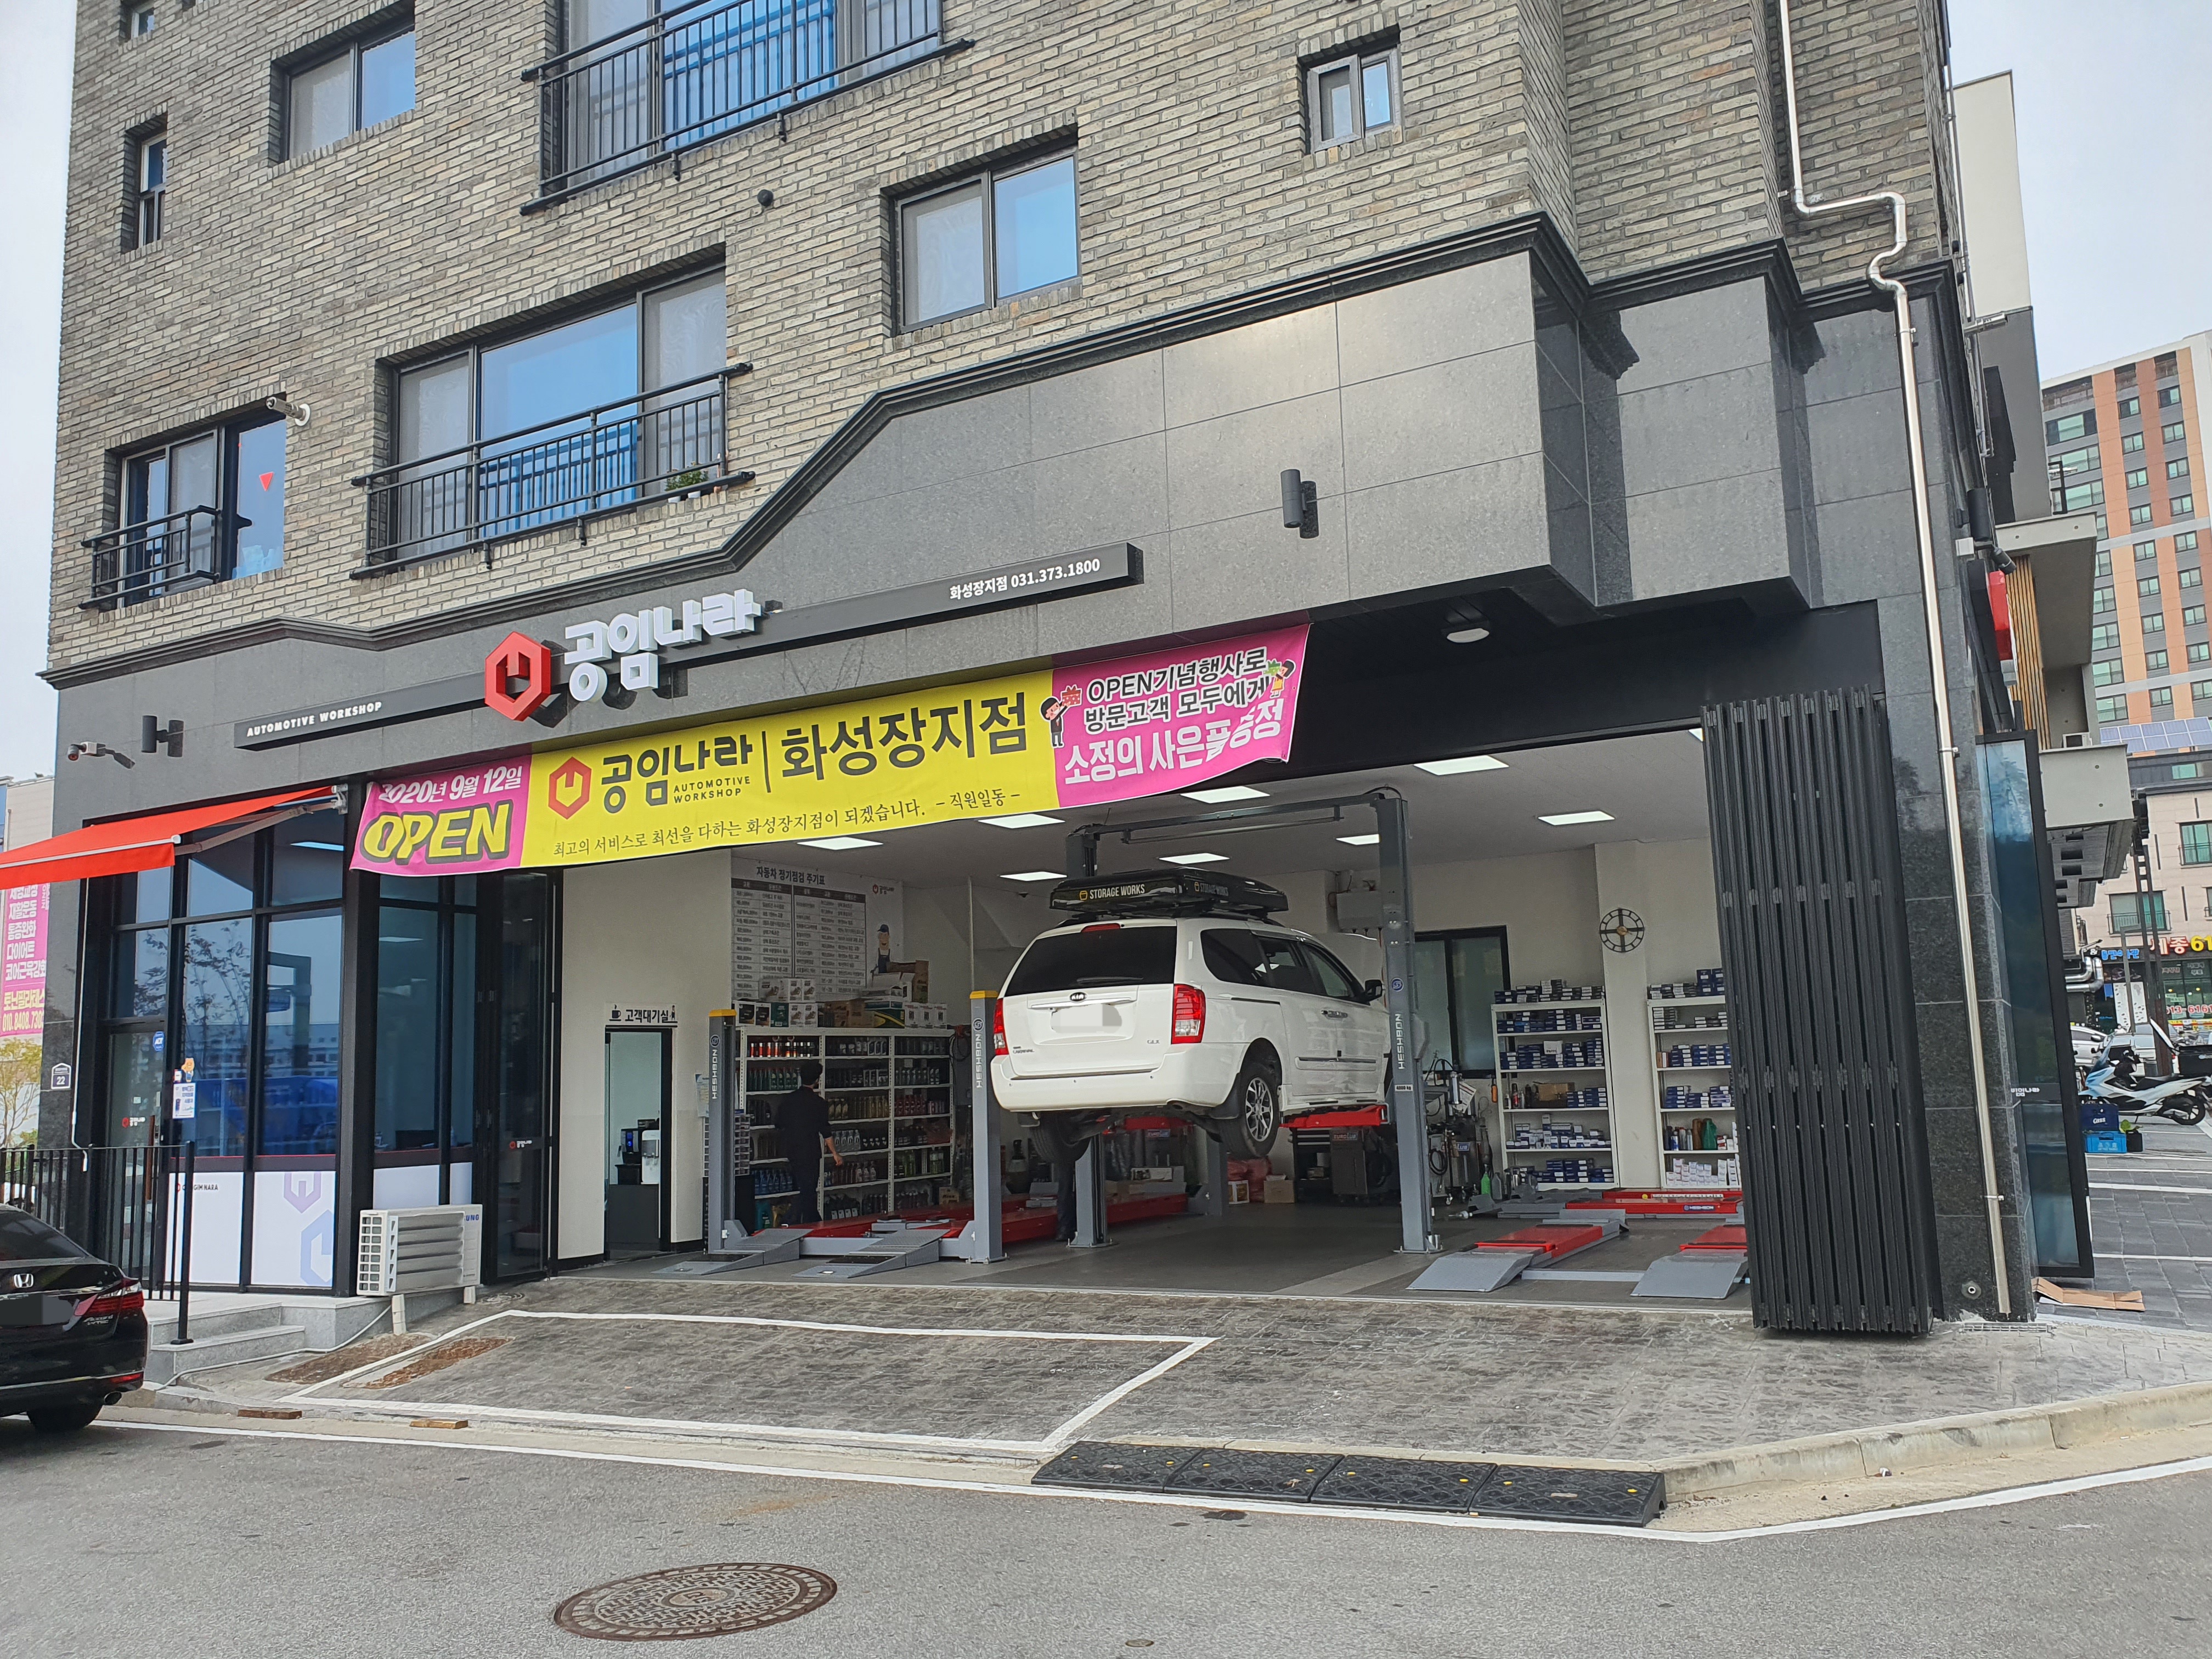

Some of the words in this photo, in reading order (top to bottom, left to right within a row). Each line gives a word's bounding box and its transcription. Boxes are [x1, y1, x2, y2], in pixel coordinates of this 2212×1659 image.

[950, 575, 1007, 600] 화성장지점
[1011, 558, 1101, 588] 031.373.1800
[564, 588, 761, 702] 공임나라
[1087, 646, 1267, 704] OPEN기념행사로
[247, 715, 315, 737] AUTOMOTIVE
[319, 701, 382, 723] WORKSHOP
[1085, 693, 1171, 735] 방문고객
[781, 692, 1027, 781] 화성장지점
[601, 734, 753, 814] 공임나라
[1064, 736, 1144, 785] 소정의
[449, 775, 479, 800] 9월
[483, 766, 523, 795] 12일
[673, 776, 751, 793] AUTOMOTIVE
[673, 788, 742, 804] WORKSHOP
[362, 801, 512, 862] OPEN
[554, 838, 590, 858] 최고의
[594, 833, 647, 854] 서비스로
[652, 825, 695, 847] 최선을
[698, 821, 742, 841] 다하는
[746, 809, 838, 836] 화성장지점이
[844, 799, 926, 825] 되겠습니다.
[757, 866, 777, 878] 자동차
[778, 869, 805, 884] 정기점검
[806, 873, 825, 885] 주기표
[1090, 886, 1119, 900] STORAGE
[1120, 884, 1146, 896] WORKS
[9, 900, 38, 920] 재활운동
[8, 919, 37, 941] 통증완화
[7, 940, 35, 961] 다이어트
[1071, 992, 1085, 1001] KIA
[624, 1008, 669, 1024] 고객대기실
[1395, 1013, 1406, 1070] HESHBON
[974, 1033, 984, 1088] HESHBON
[57, 1076, 65, 1085] 22
